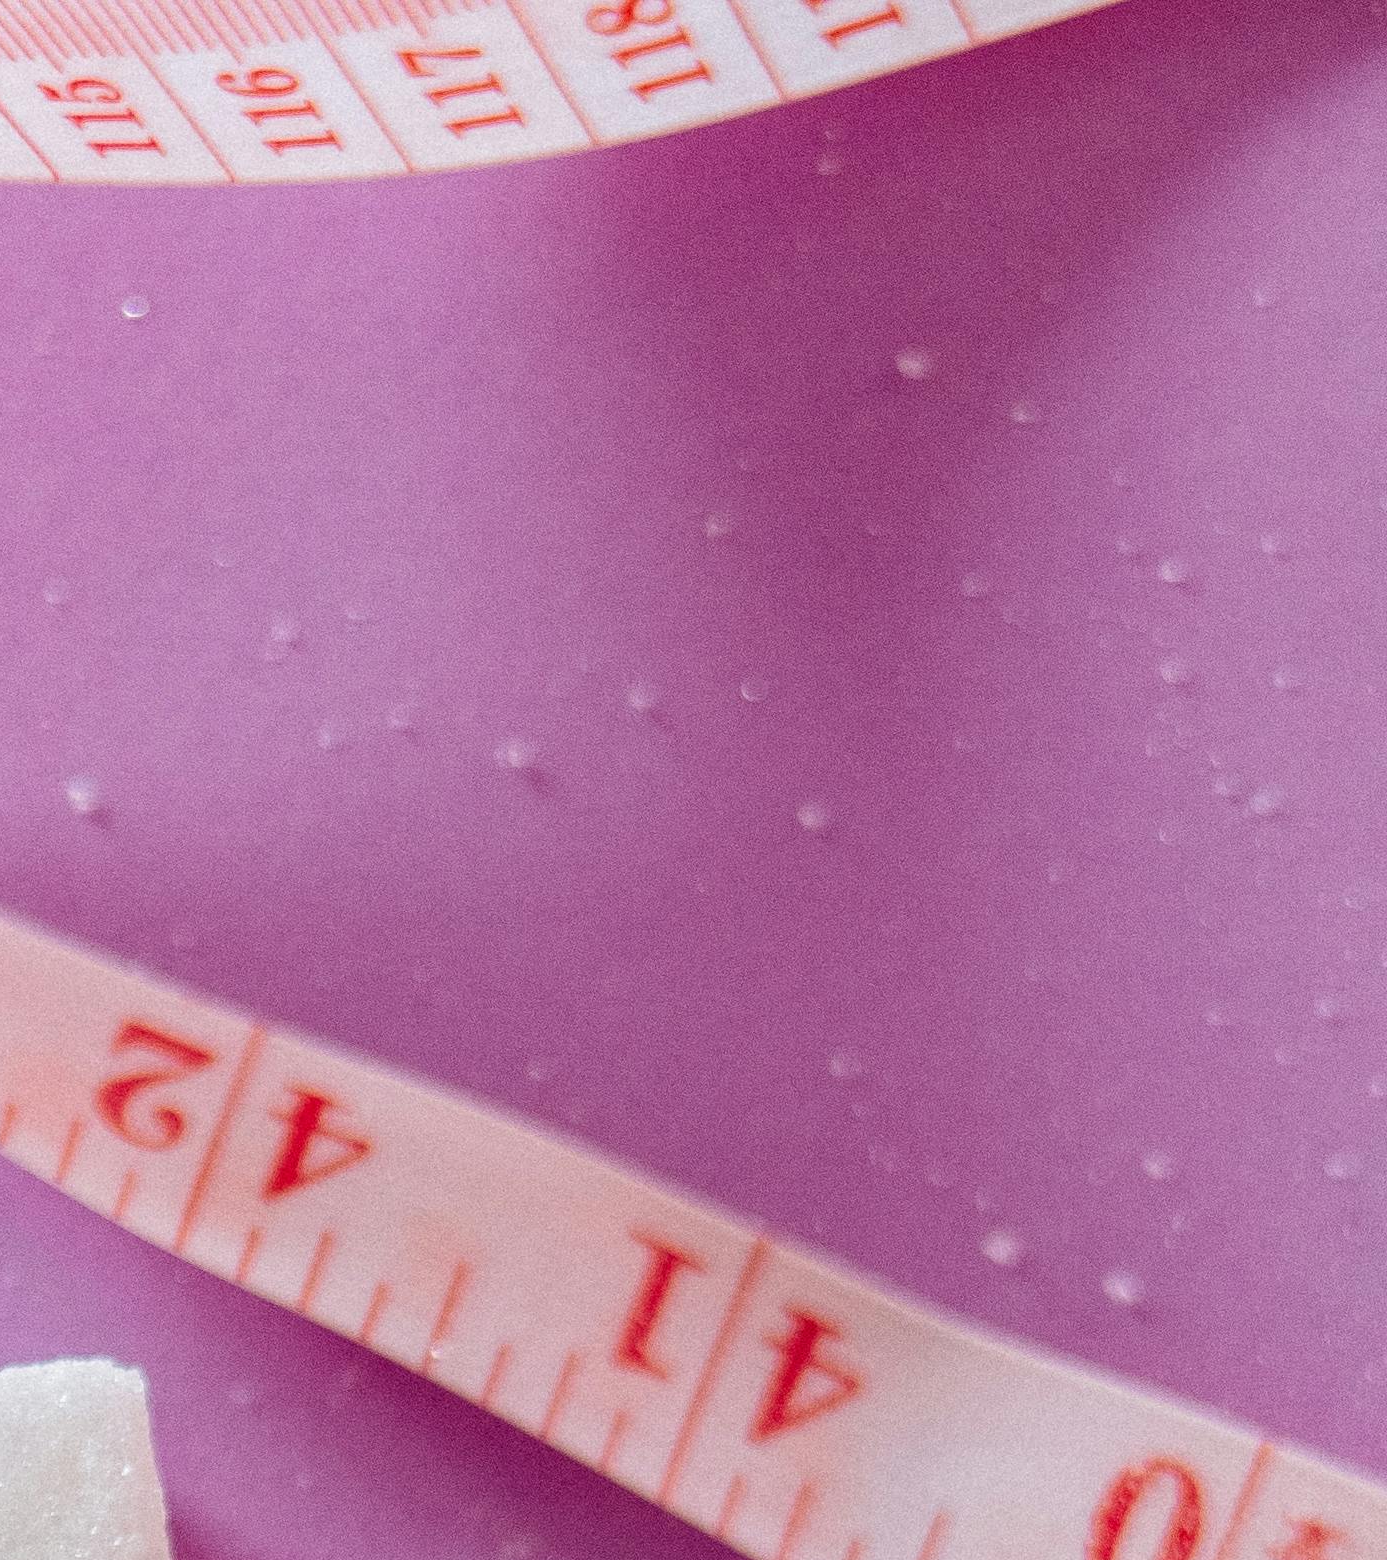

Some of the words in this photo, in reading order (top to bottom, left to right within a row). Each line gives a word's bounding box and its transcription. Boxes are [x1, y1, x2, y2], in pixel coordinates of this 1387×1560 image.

[37, 77, 165, 158] 115
[214, 66, 345, 156] 116
[397, 43, 526, 141] 117
